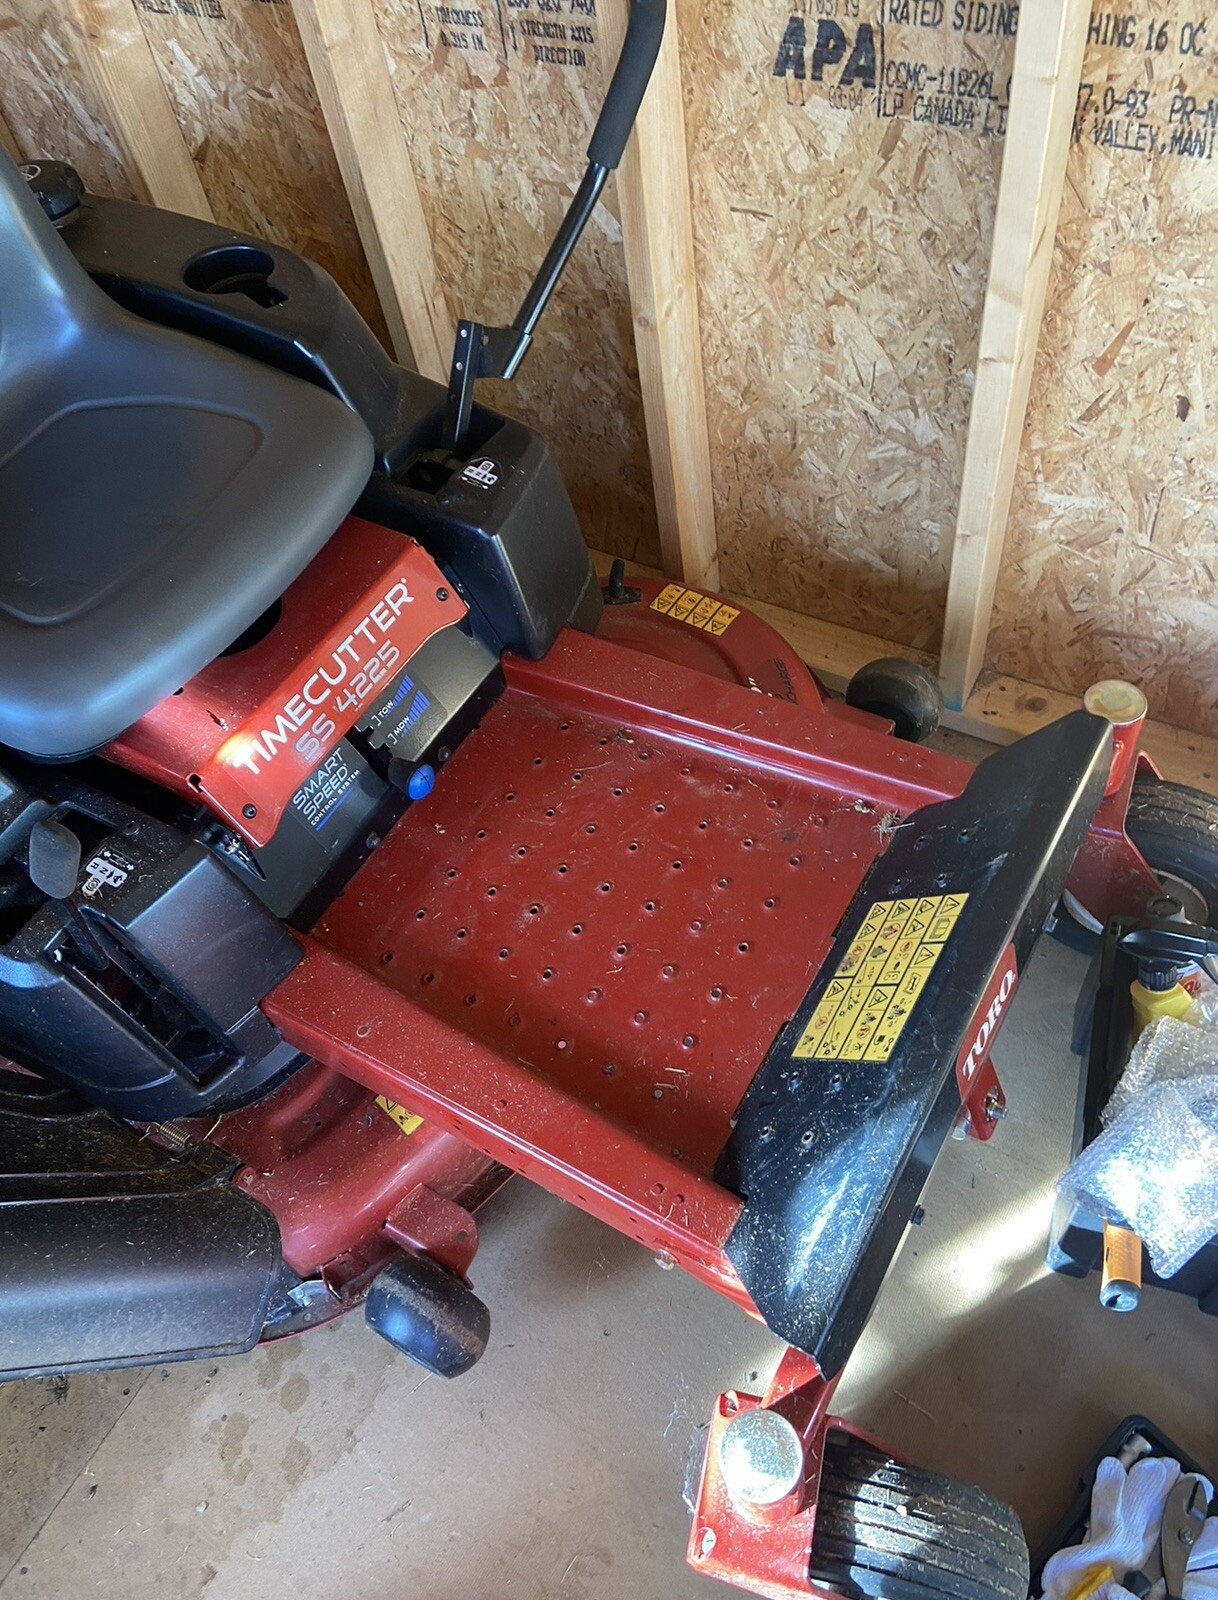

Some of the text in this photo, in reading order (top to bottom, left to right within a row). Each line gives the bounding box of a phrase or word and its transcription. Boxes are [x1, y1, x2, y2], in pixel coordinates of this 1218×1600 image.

[434, 5, 485, 27] THICKNESS
[519, 20, 594, 43] STRENGTH AXIS
[889, 0, 1019, 36] RATED SIDING
[1086, 12, 1138, 47] HING
[1145, 18, 1170, 51] 16
[532, 45, 586, 67] DIRECTION
[772, 16, 876, 89] APA
[882, 91, 904, 118] LP
[913, 95, 975, 129] CANADA
[1168, 95, 1218, 129] PR-N
[232, 582, 415, 775] TIMECUTTER
[296, 639, 401, 761] SS 4225
[377, 699, 394, 718] TOW
[393, 715, 410, 736] MOW
[292, 747, 343, 811] SMART
[303, 765, 348, 820] SPEED
[310, 769, 360, 826] CONTROL SYSTEM
[962, 969, 1016, 1081] TORO
